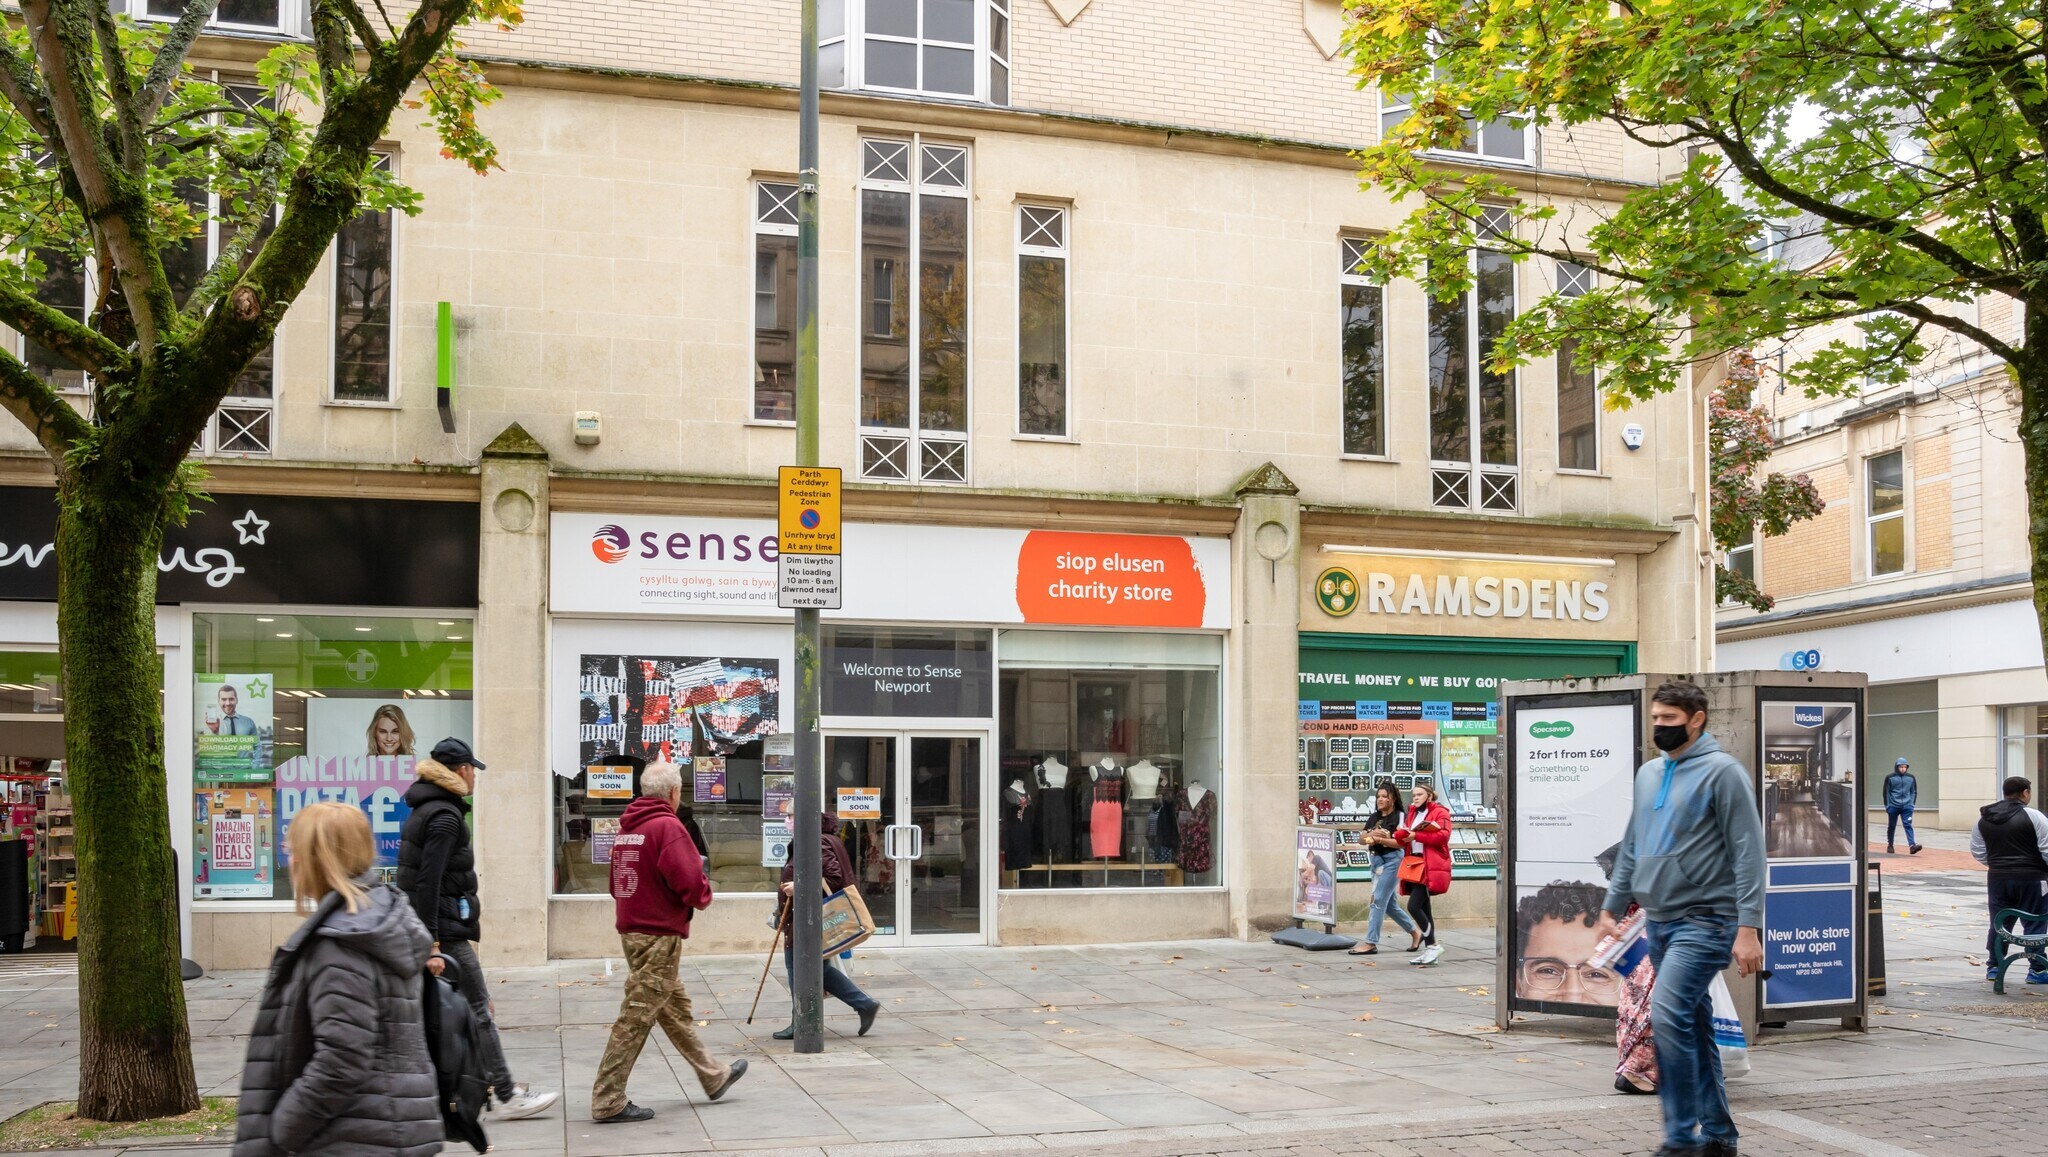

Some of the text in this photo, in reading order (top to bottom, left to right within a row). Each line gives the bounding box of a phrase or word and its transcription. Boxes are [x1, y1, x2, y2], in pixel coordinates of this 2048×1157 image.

[799, 470, 822, 478] Parth
[791, 478, 829, 487] Cerddwyr
[789, 489, 832, 498] Pedestrian
[800, 498, 820, 506] Zone
[784, 531, 836, 540] Unrhyw bryd
[639, 531, 779, 563] sense
[799, 544, 813, 552] any
[815, 543, 833, 551] time
[786, 556, 834, 565] Dim llwytho
[1055, 551, 1165, 574] siop elusen
[788, 568, 832, 577] No loading
[639, 575, 679, 586] cysylltu
[681, 576, 715, 587] golwg,
[718, 577, 739, 586] sain
[751, 577, 778, 589] bywy
[815, 577, 821, 585] 6
[639, 589, 692, 600] connecting
[719, 591, 747, 600] sound
[749, 591, 766, 600] and
[768, 591, 778, 600] lif
[781, 585, 838, 594] diwrnod nesaf
[1048, 579, 1173, 604] charity store
[792, 597, 827, 606] next day
[1367, 571, 1611, 622] RAMSDENS
[843, 663, 962, 678] Welcome to Sense
[1298, 672, 1350, 684] TRAVEL
[1355, 674, 1402, 686] MONEY
[1419, 676, 1439, 687] WE
[1443, 677, 1471, 687] BUY
[874, 680, 931, 695] Newport
[1795, 713, 1822, 722] Wickes
[1332, 723, 1359, 732] HAND
[1360, 723, 1404, 732] BARGAINS
[1443, 720, 1464, 729] NEW
[1532, 726, 1571, 734] Specsavers
[199, 736, 255, 744] DOWNLOAD OUR
[1529, 748, 1610, 760] 2 for 1 from £69
[280, 754, 414, 783] UNLIMITE
[1529, 763, 1590, 774] Something to
[1529, 773, 1581, 783] smile about
[215, 821, 251, 833] AMAZING
[215, 832, 252, 844] MEMBER
[1302, 836, 1331, 850] LOANS
[216, 844, 252, 860] DEALS
[1767, 927, 1850, 941] New look store
[1782, 941, 1836, 955] now open
